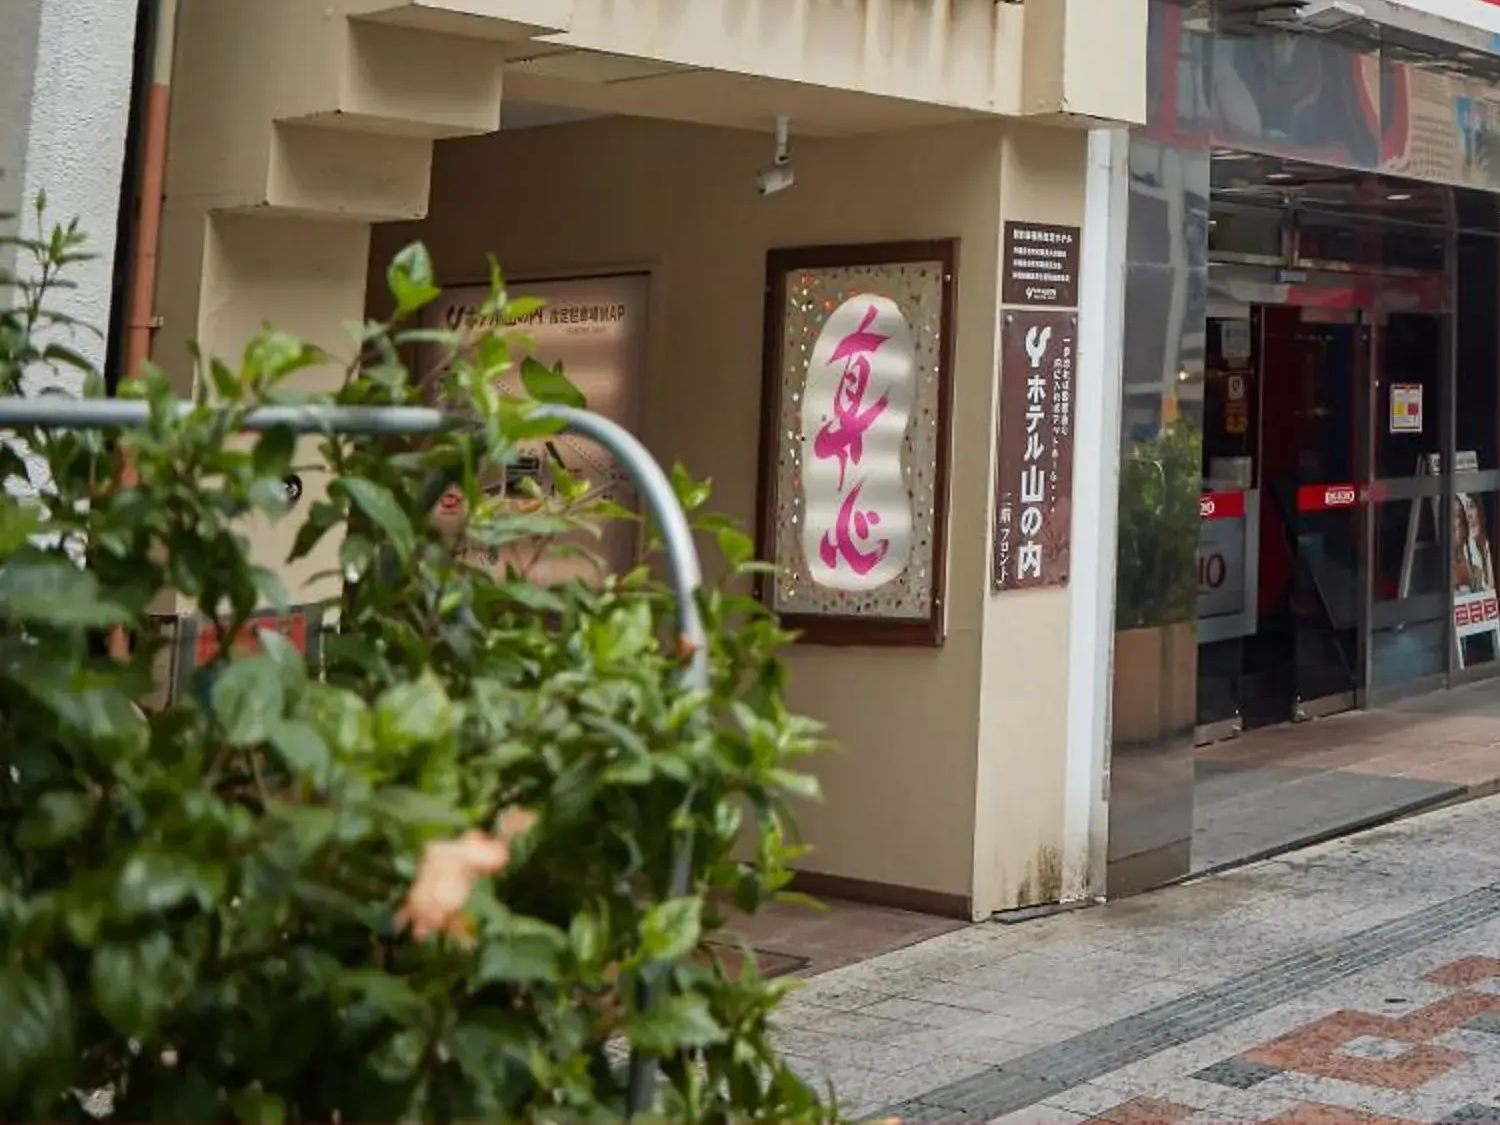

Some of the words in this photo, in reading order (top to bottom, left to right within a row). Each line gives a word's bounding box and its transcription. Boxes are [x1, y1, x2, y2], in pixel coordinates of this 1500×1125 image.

[1016, 374, 1047, 580] ホテル山の内
